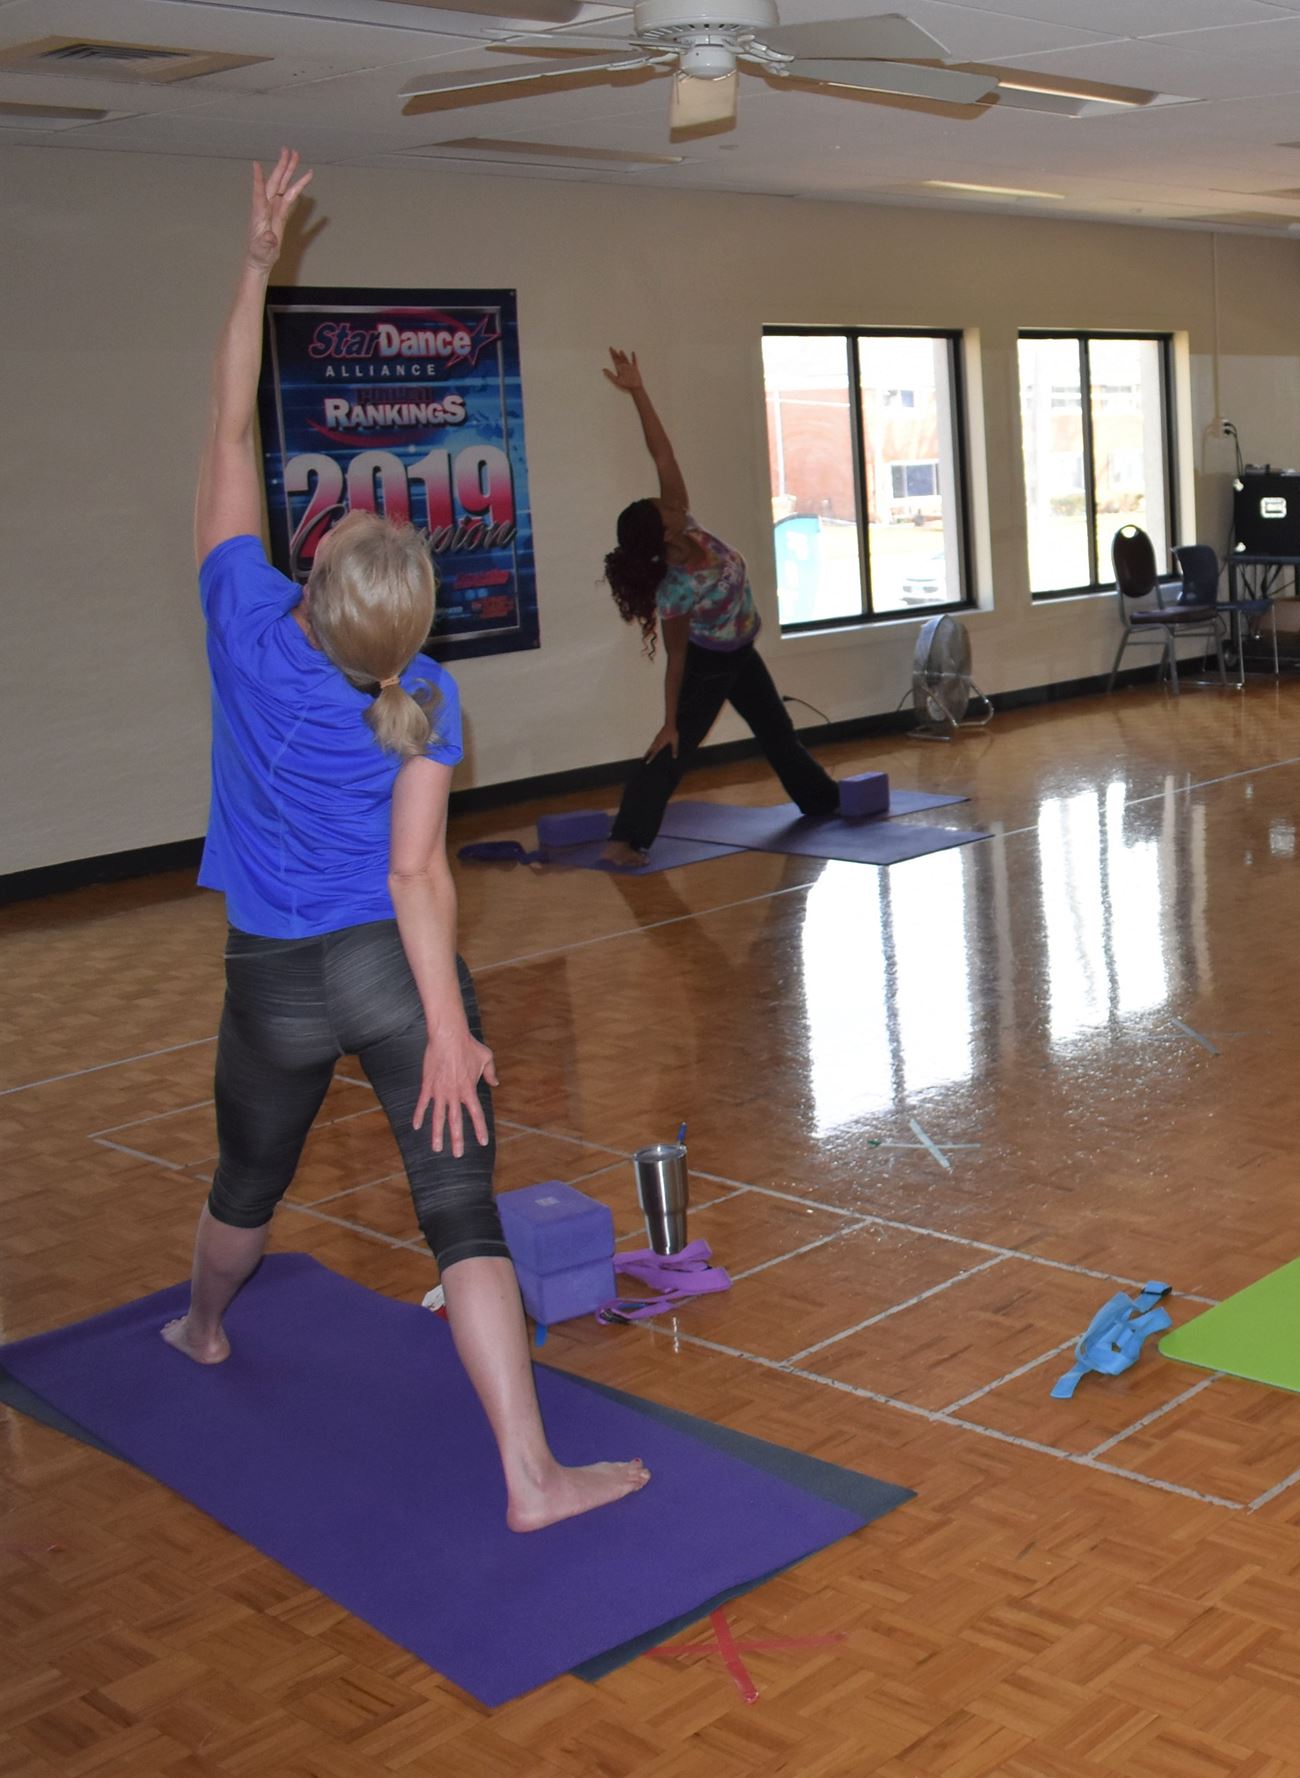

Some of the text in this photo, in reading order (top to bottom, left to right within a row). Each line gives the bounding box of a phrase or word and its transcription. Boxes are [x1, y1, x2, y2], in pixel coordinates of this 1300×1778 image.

[325, 364, 437, 378] ALLIANCE
[324, 393, 467, 428] RANKINGS
[284, 445, 515, 557] 2019
